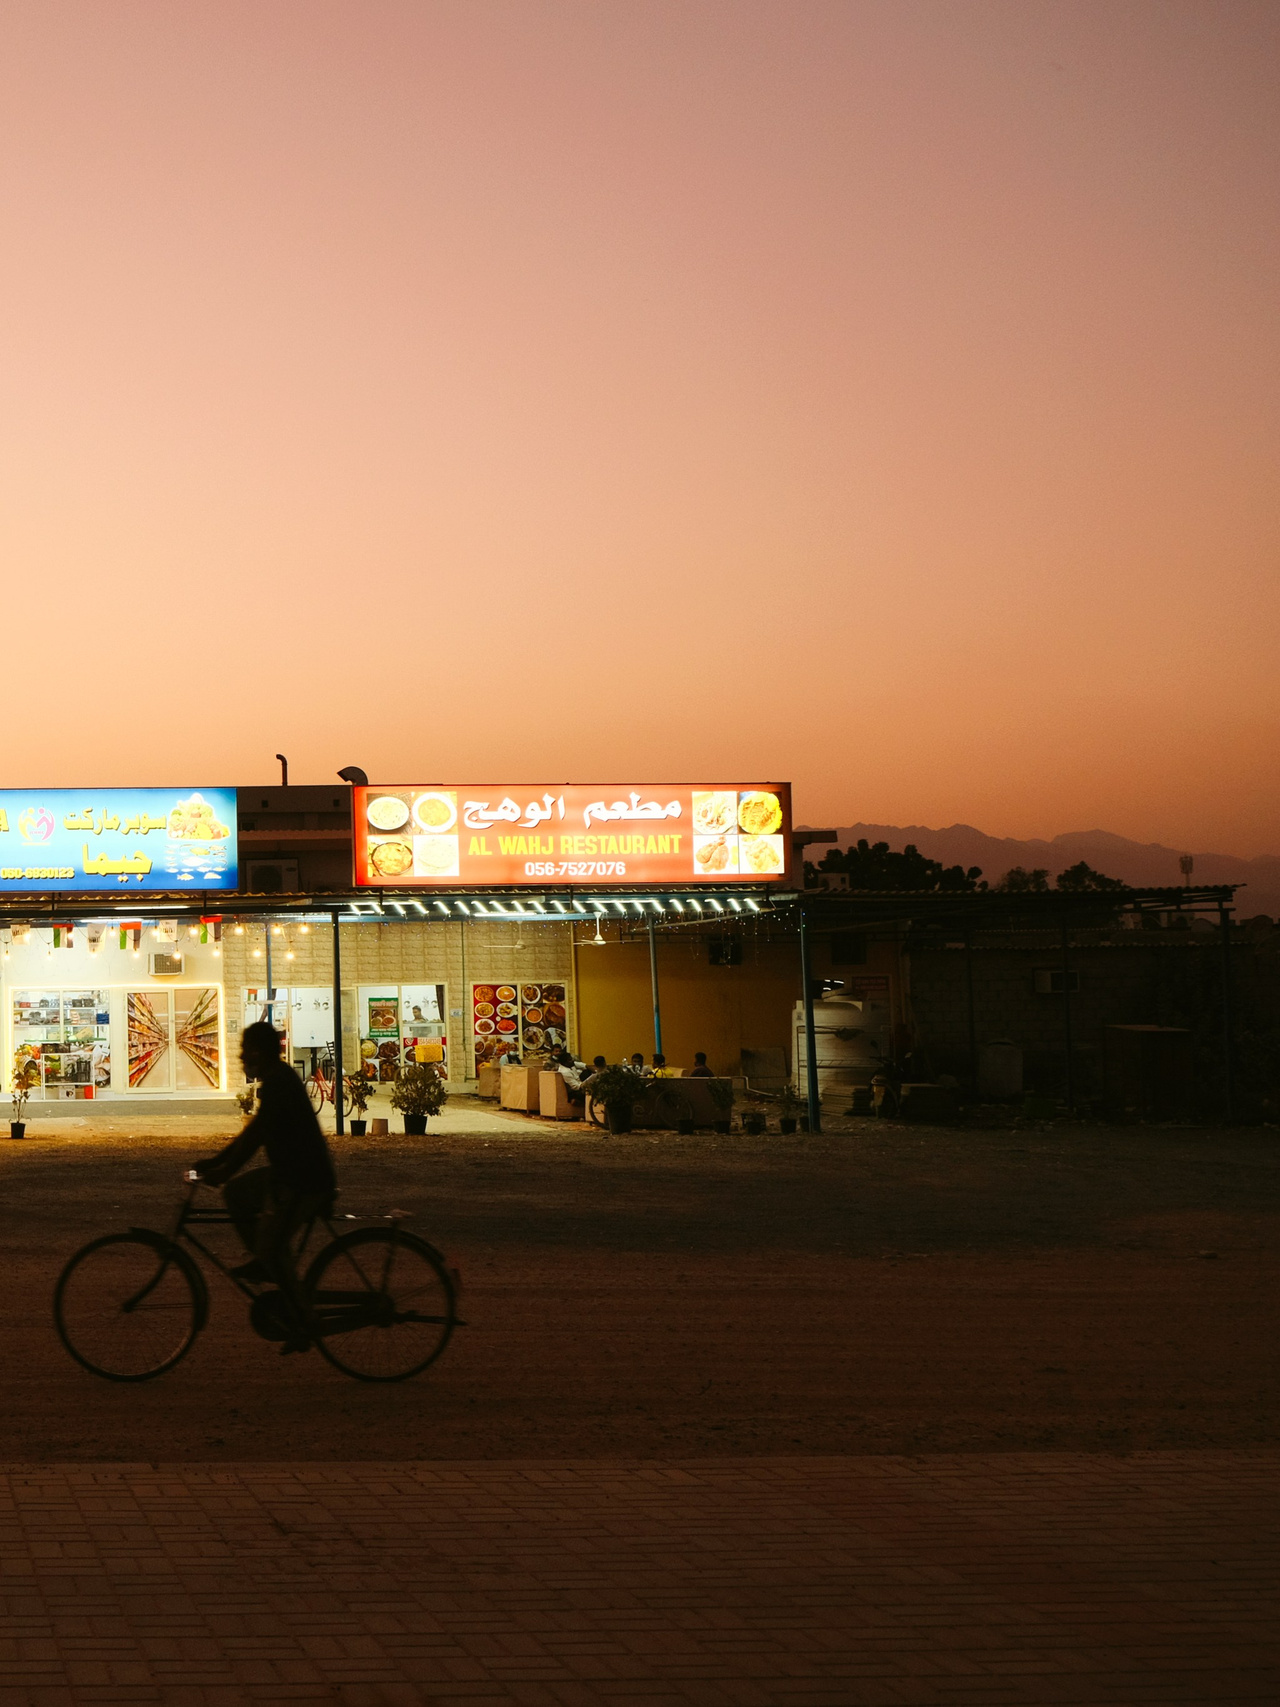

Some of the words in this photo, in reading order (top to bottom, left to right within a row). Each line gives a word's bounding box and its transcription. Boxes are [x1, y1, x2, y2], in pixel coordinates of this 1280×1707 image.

[63, 807, 121, 835] ماركت
[120, 812, 167, 835] سوبر
[463, 792, 566, 829] الوهج
[583, 791, 682, 829] مطعم
[468, 836, 493, 855] AL
[498, 835, 554, 855] WAHJ
[560, 834, 682, 855] RESTAURANT
[82, 842, 153, 883] جيما
[525, 861, 626, 876] 056-7527076
